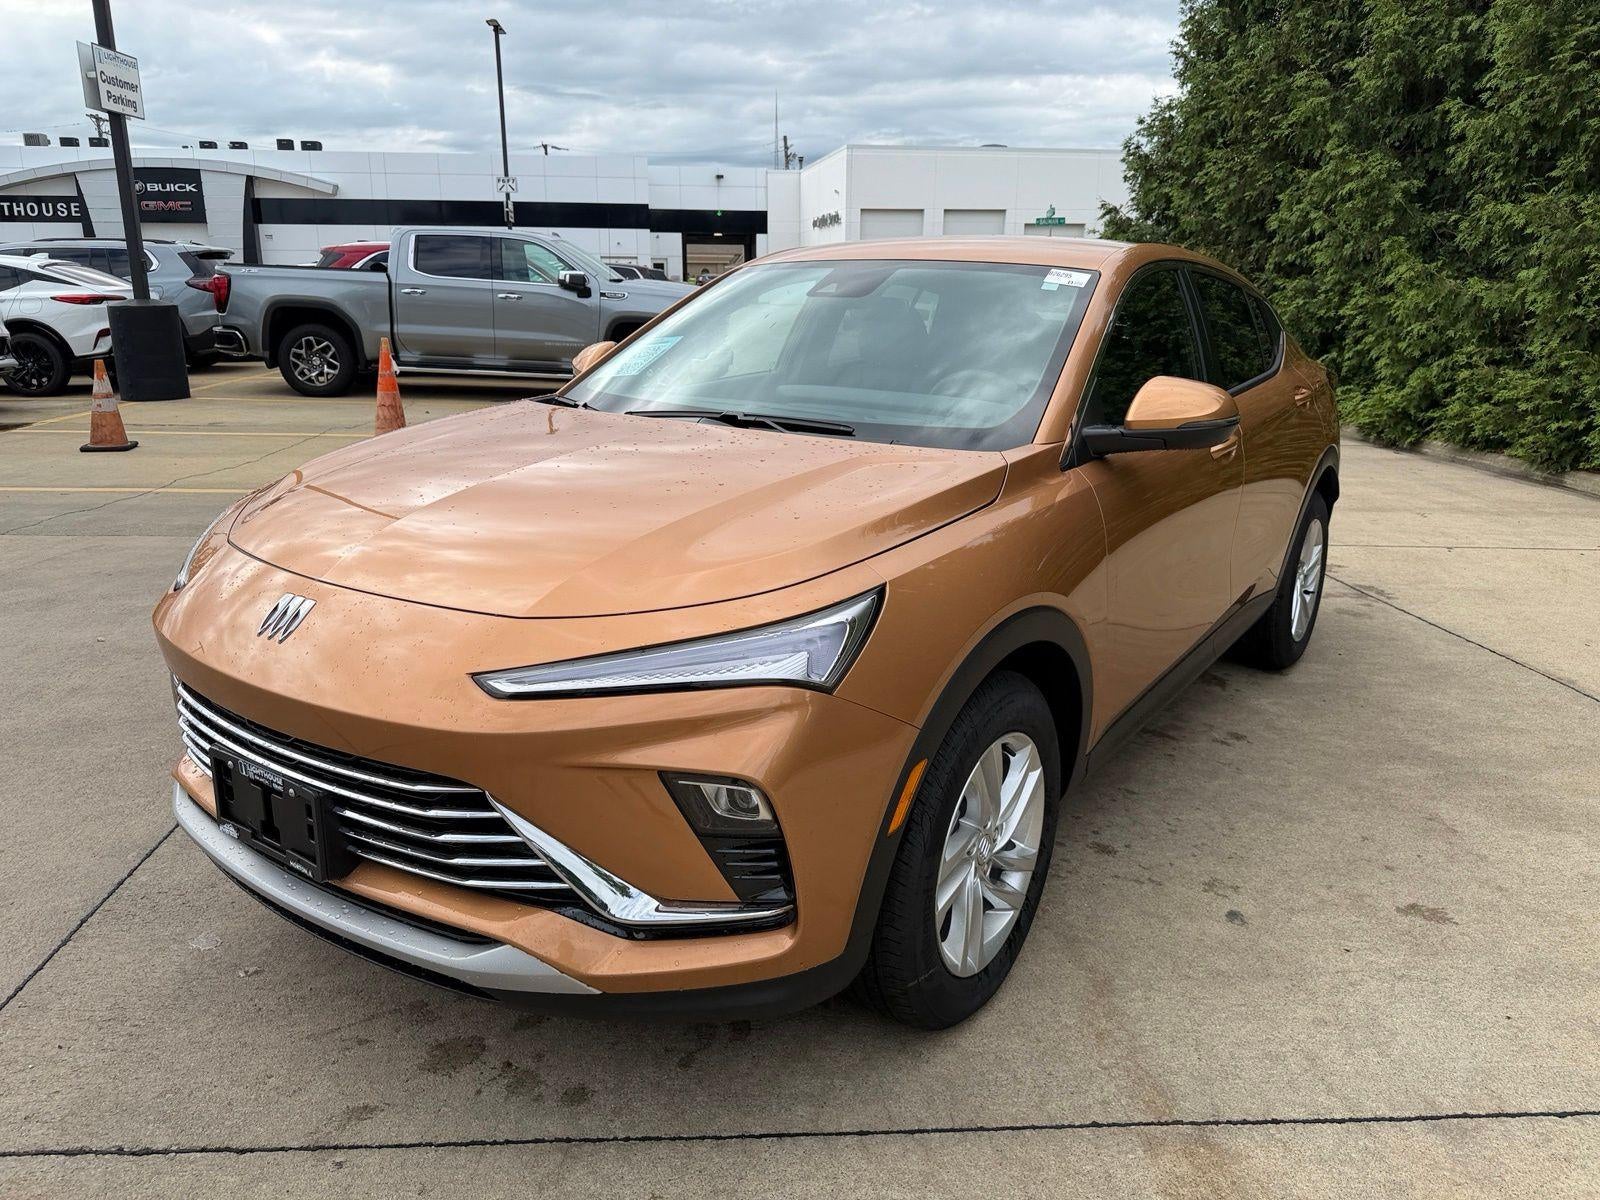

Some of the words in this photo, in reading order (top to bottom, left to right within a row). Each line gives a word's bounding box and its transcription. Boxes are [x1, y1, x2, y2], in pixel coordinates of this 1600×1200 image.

[100, 70, 139, 93] Customer
[106, 89, 138, 113] Parking
[147, 183, 199, 192] BUICK
[140, 200, 192, 211] GMC
